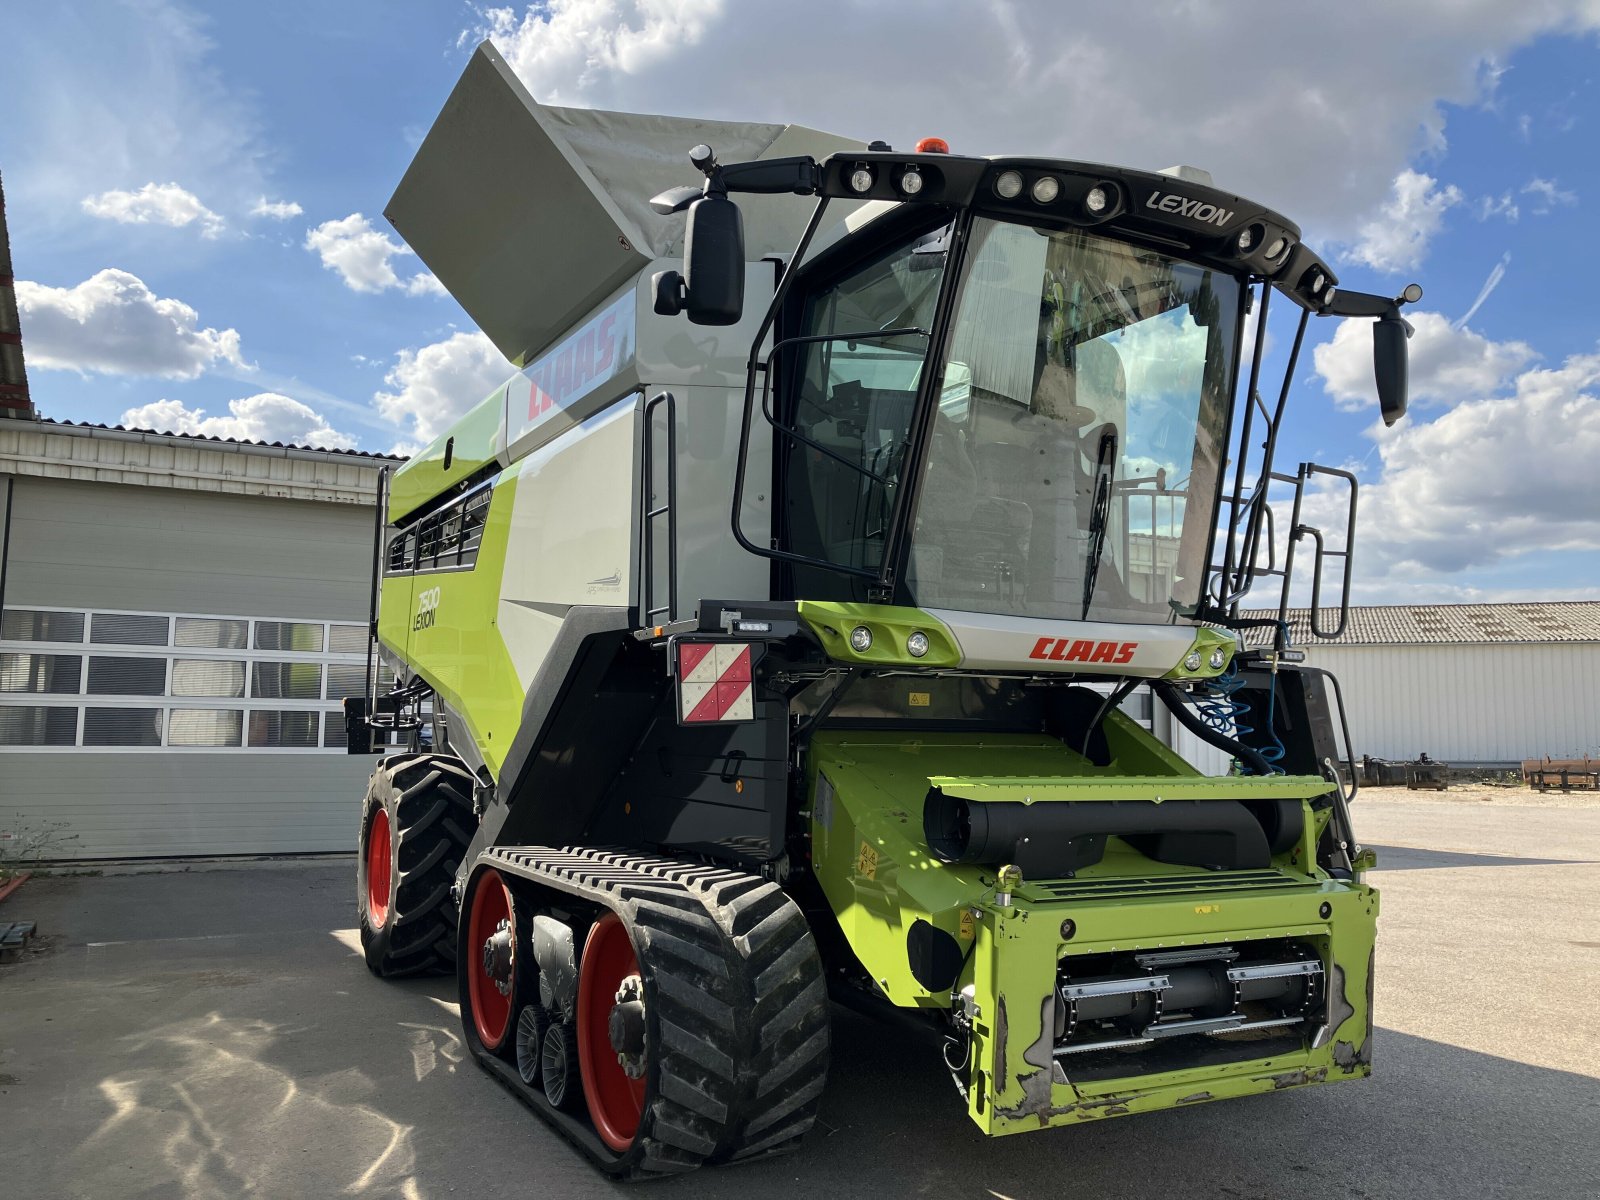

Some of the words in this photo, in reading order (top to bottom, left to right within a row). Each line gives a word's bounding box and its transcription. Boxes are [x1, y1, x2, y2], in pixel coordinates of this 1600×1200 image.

[1145, 191, 1235, 227] LEXION
[527, 313, 617, 422] CLAAS
[413, 608, 436, 632] LEXION
[1029, 637, 1139, 664] CLAAS
